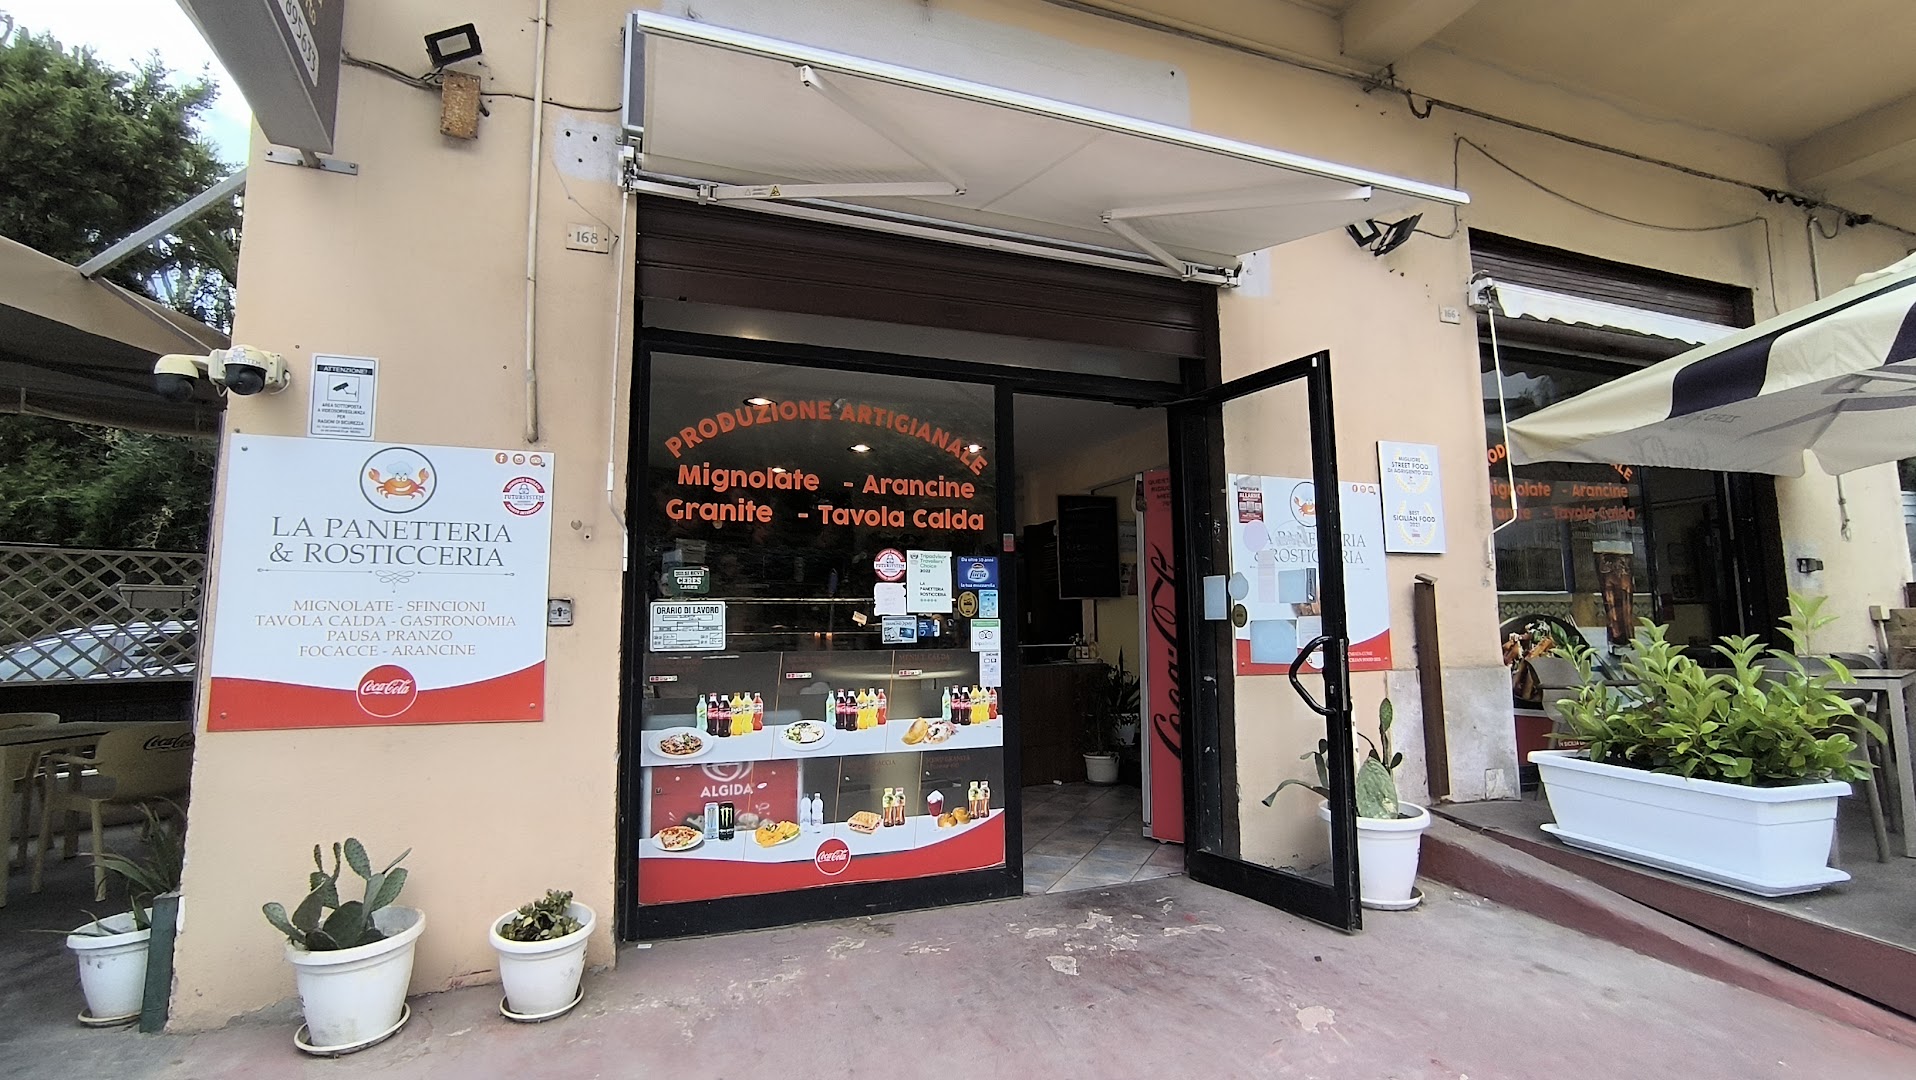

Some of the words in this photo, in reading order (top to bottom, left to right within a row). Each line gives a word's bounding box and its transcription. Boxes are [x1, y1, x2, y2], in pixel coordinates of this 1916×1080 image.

[576, 231, 599, 245] 168
[323, 366, 368, 374] ATTENZIONE!
[664, 400, 833, 459] PRODUZIONE
[839, 402, 989, 476] ARTIGIANALE
[1391, 461, 1411, 469] STREET
[677, 461, 820, 493] Mignolate
[862, 474, 976, 499] Arancine
[1571, 482, 1630, 498] Arancine
[665, 497, 774, 523] Granite
[817, 504, 905, 528] Tavola
[912, 508, 985, 531] Calda
[1393, 514, 1418, 522] SICILIAN
[1553, 506, 1596, 520] Tavola
[272, 516, 315, 538] LA
[325, 517, 513, 543] PANETTERIA
[269, 542, 294, 563] &
[303, 542, 505, 567] ROSTICCERIA
[676, 577, 702, 585] CERES
[292, 600, 394, 612] MIGNOLATE
[407, 600, 486, 612] SFINCIONI
[656, 606, 683, 615] ORARIO
[684, 606, 692, 614] DI
[692, 606, 719, 614] LAVORO
[254, 615, 323, 627] TAVOLA
[328, 615, 386, 627] CALDA
[400, 615, 517, 627] GASTRONOMIA
[327, 630, 381, 642] PAUSA
[386, 629, 454, 641] PRANZO
[299, 645, 379, 657] FOCACCE
[391, 644, 476, 656] ARANCINE
[700, 784, 754, 798] ALGIDA
